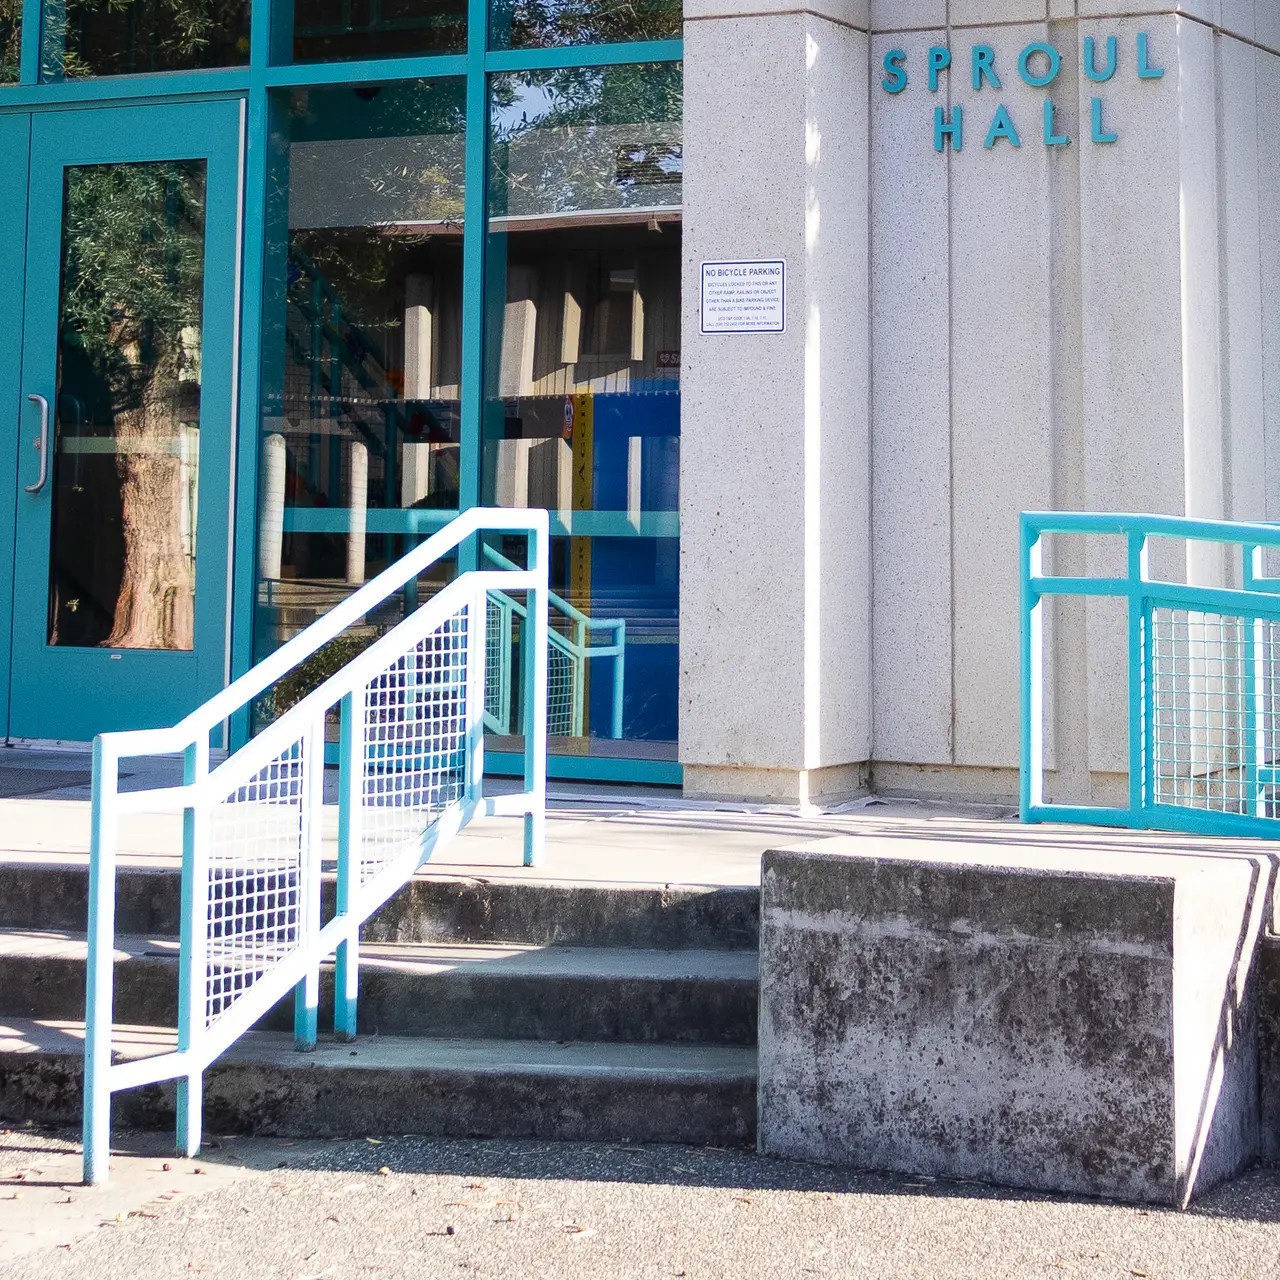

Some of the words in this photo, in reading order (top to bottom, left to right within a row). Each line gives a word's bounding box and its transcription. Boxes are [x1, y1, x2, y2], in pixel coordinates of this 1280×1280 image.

[881, 31, 1165, 93] SPROUL
[933, 97, 1118, 152] HALL
[706, 269, 716, 277] NO
[717, 268, 747, 277] BICYCLE
[749, 268, 780, 276] PARKING
